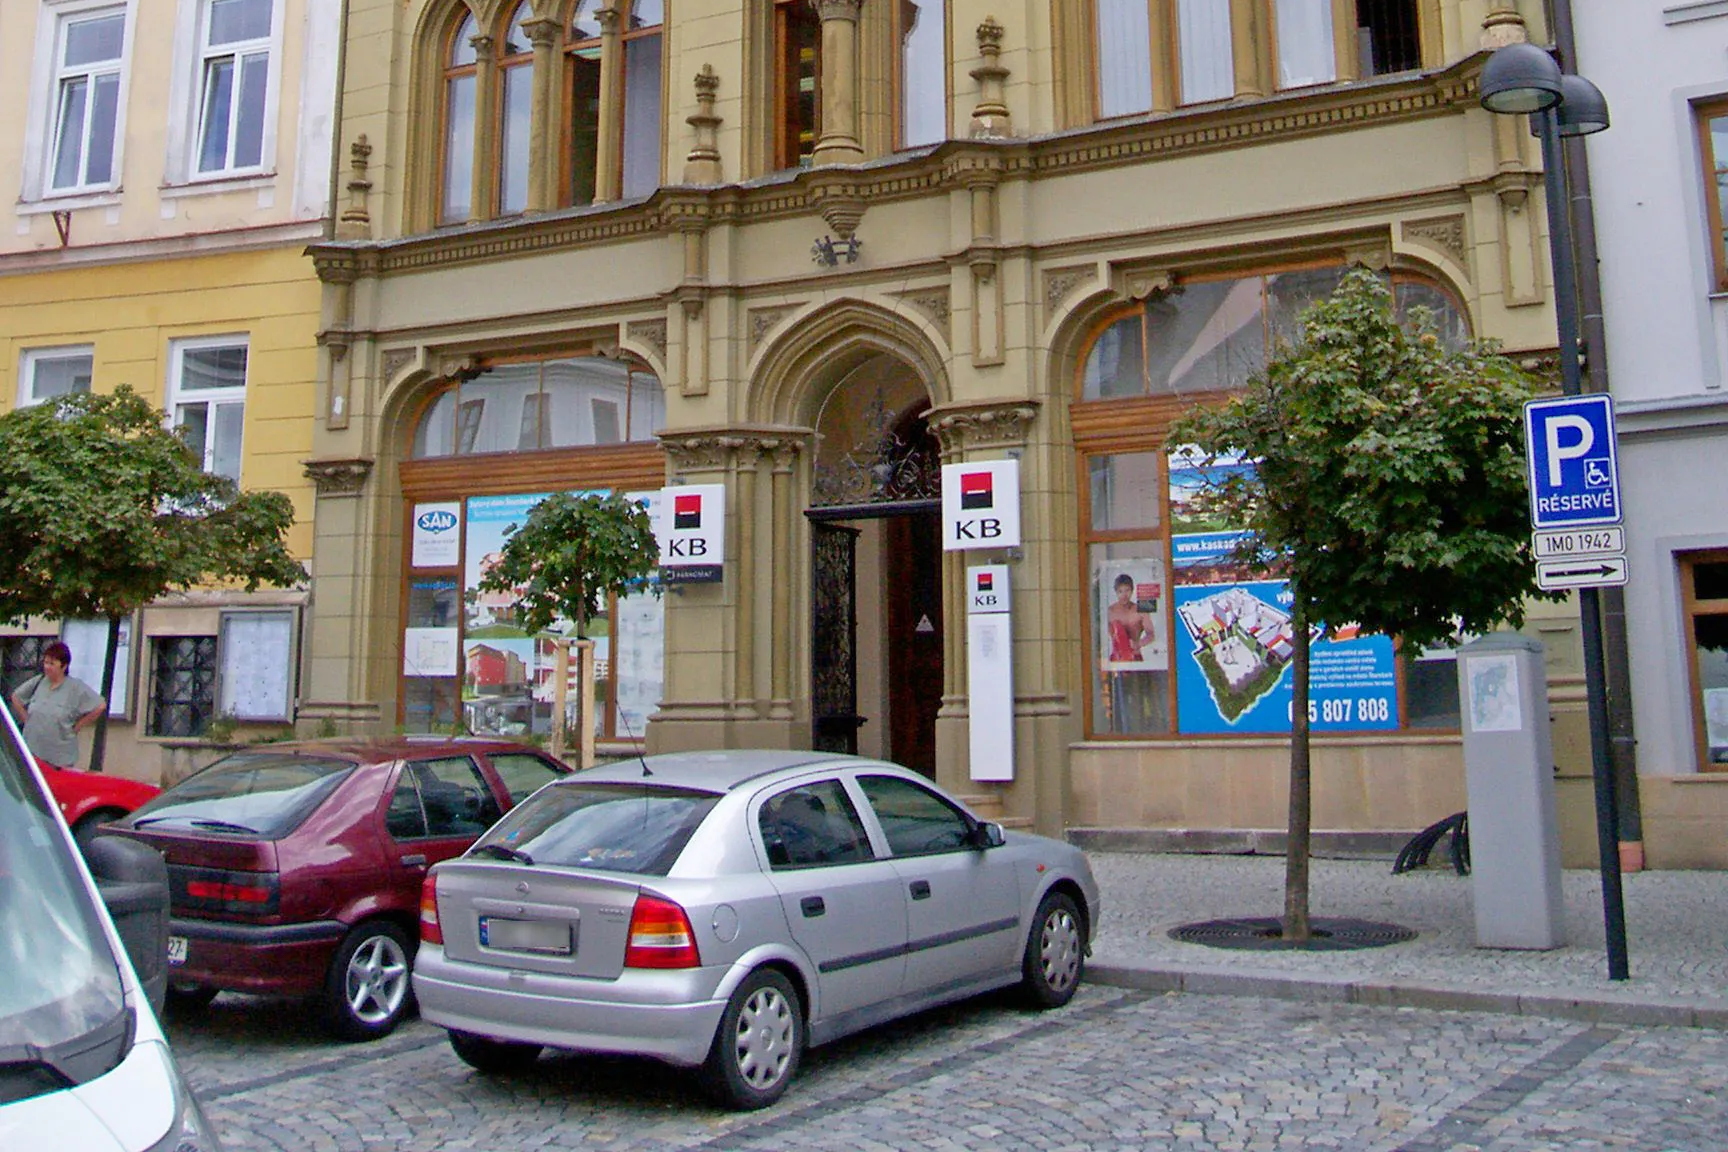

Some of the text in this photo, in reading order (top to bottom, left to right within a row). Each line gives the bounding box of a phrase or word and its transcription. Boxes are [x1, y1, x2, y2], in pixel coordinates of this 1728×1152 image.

[1545, 414, 1594, 488] P
[1538, 489, 1612, 513] RÉSERVÉ
[421, 512, 451, 528] SAN
[956, 518, 1002, 540] KB
[669, 538, 707, 557] KB
[1578, 533, 1611, 550] 1942
[975, 595, 997, 606] KB
[1322, 699, 1352, 722] 807
[1358, 698, 1389, 721] 808
